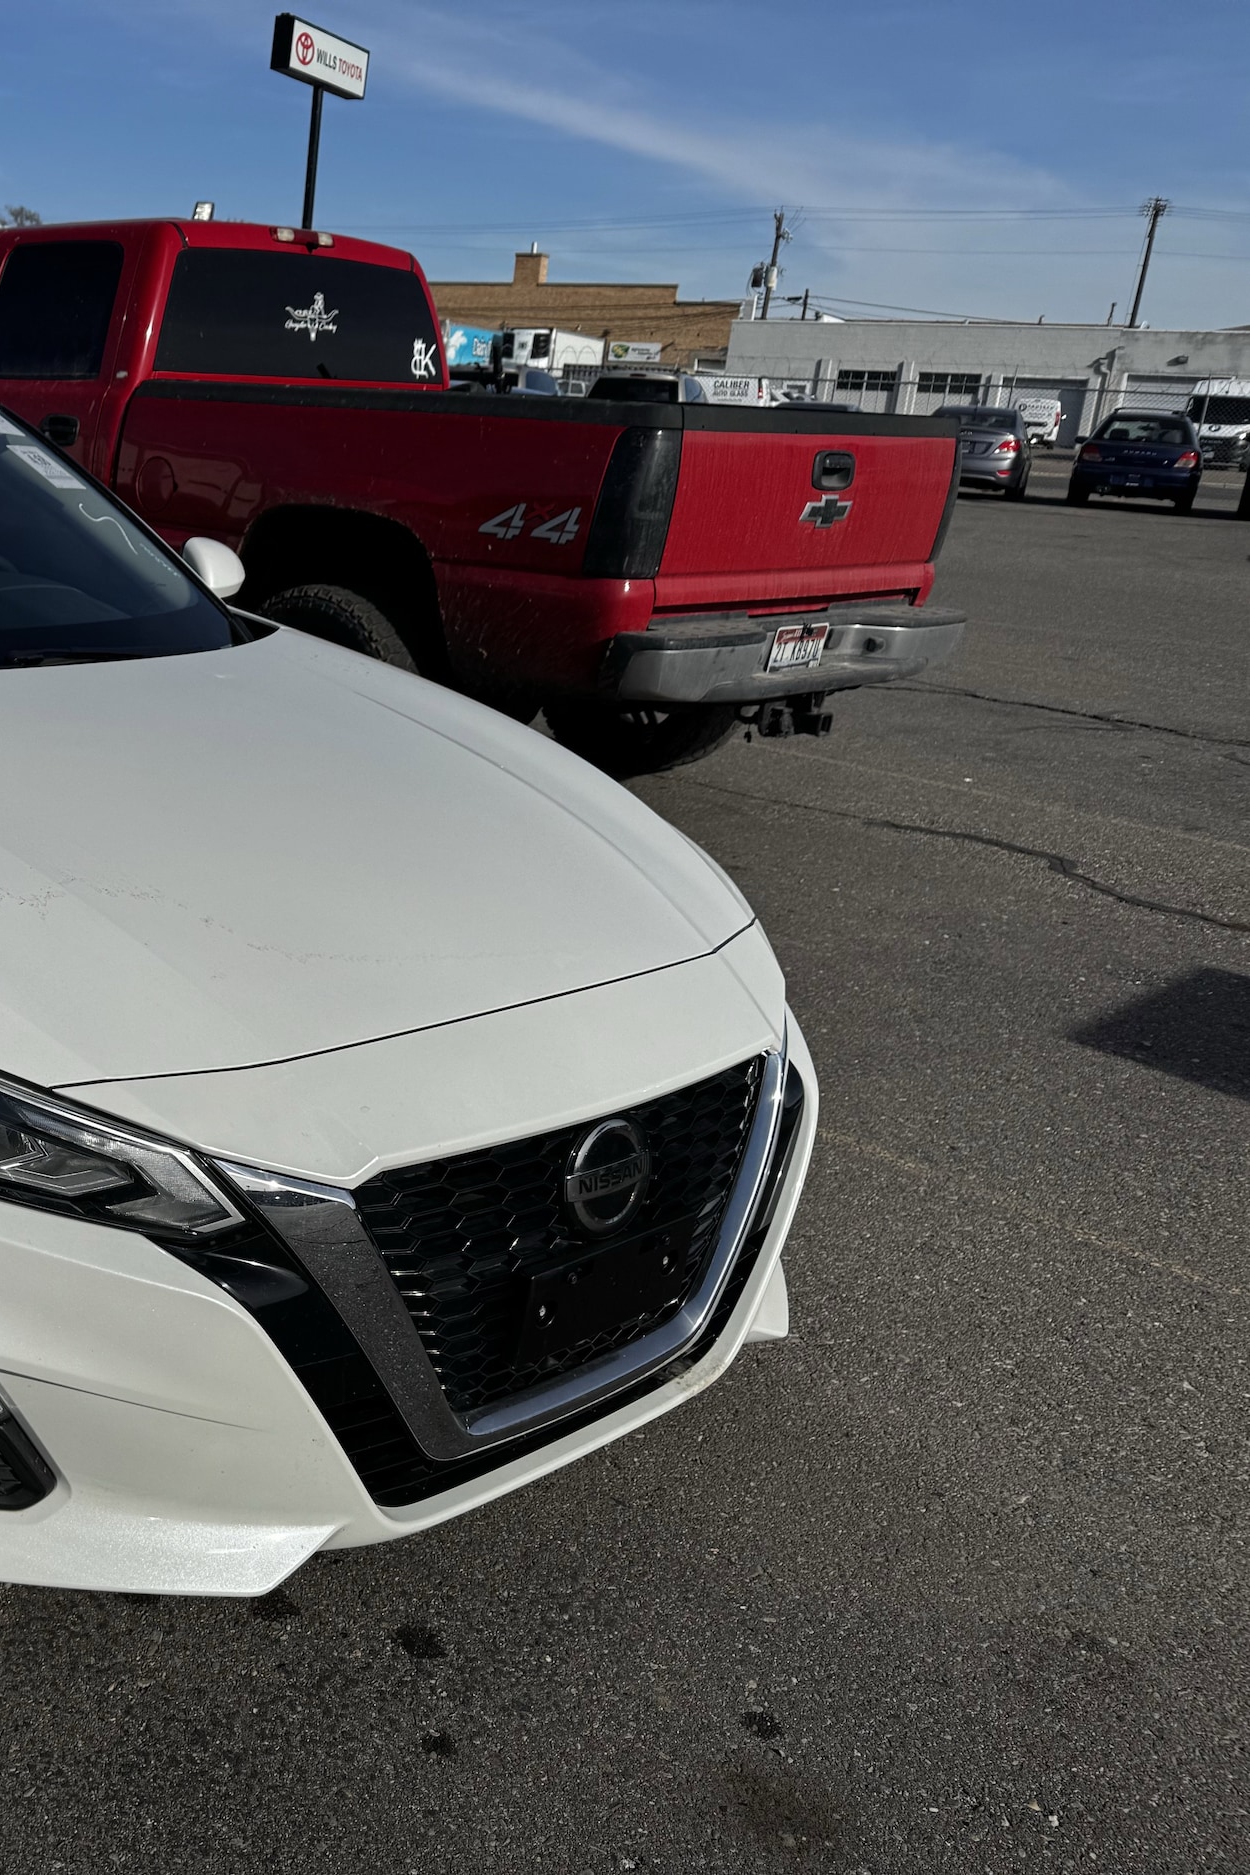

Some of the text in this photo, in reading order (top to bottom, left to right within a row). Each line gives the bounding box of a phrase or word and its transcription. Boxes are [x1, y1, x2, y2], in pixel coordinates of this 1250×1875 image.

[316, 48, 362, 82] WILLS TOYOTA
[713, 380, 750, 389] CALIBER
[730, 389, 748, 397] GLASS
[579, 1158, 643, 1195] NISSAN
